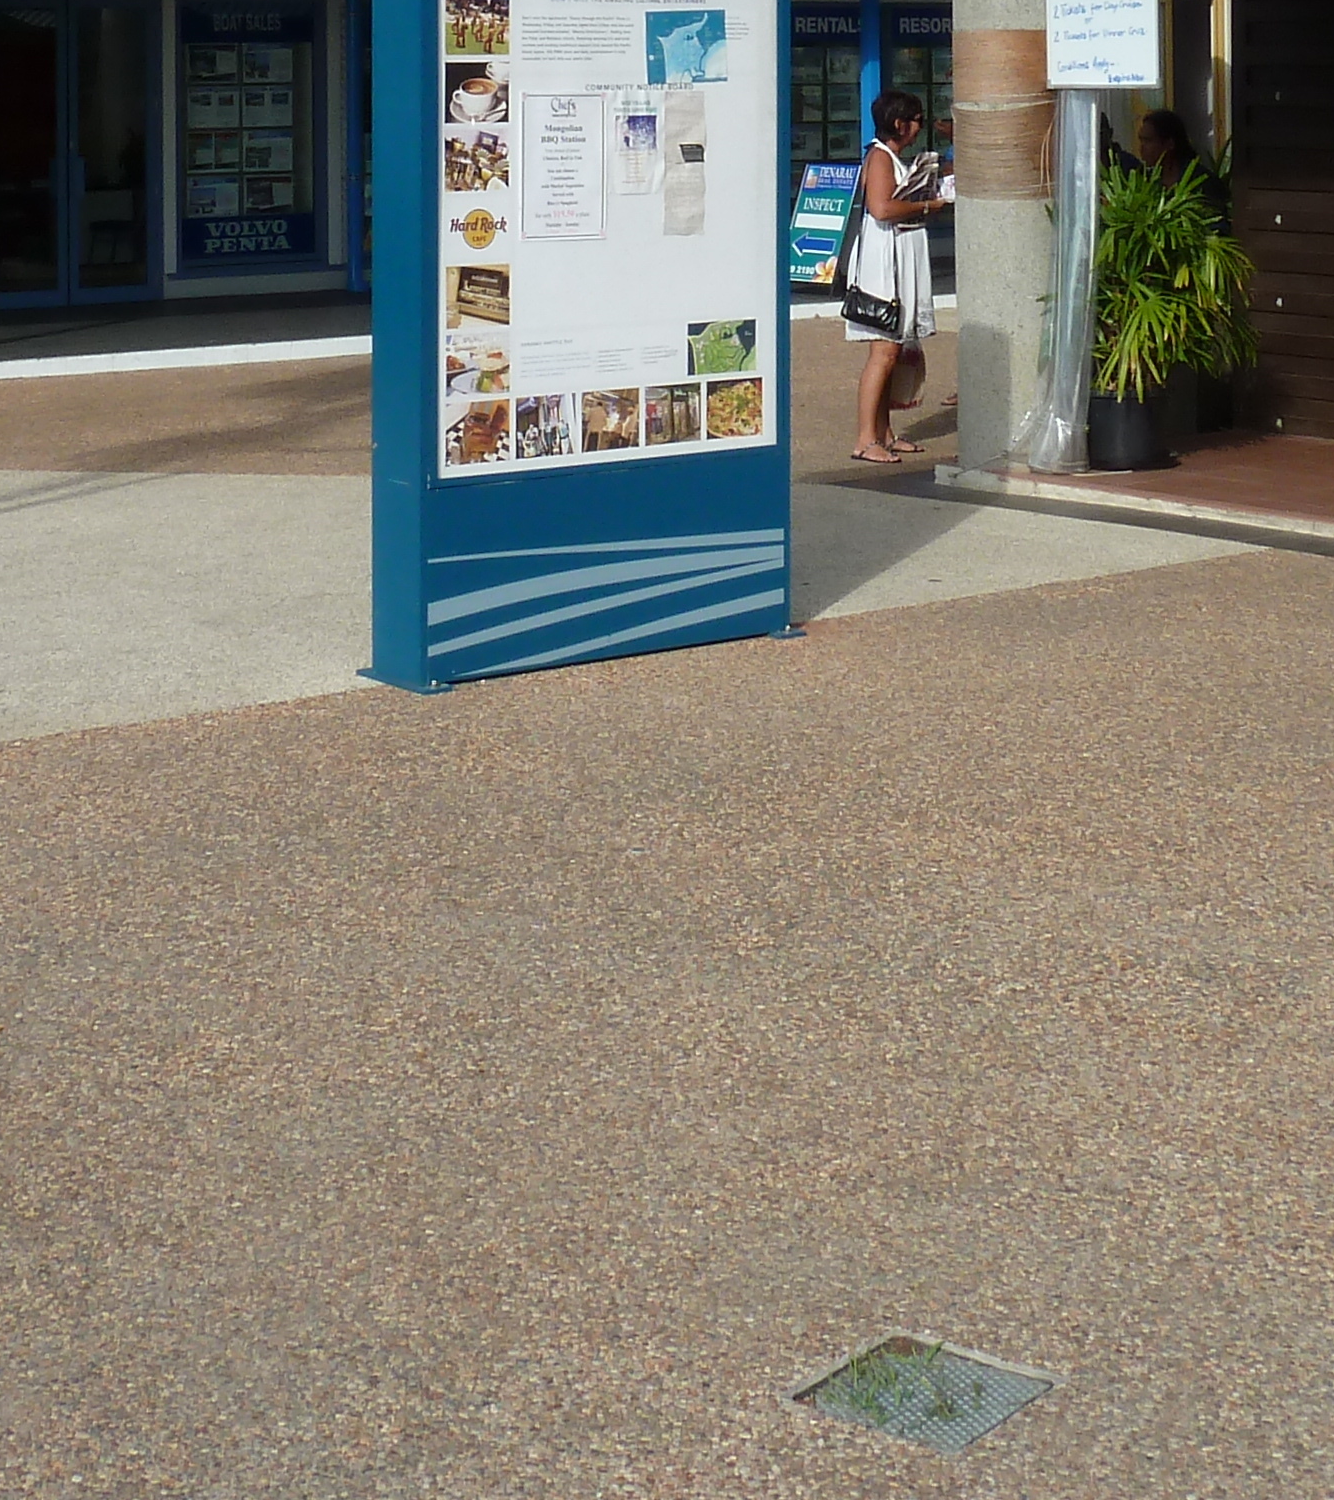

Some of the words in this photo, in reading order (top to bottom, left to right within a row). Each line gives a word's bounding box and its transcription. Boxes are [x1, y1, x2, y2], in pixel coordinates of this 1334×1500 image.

[213, 13, 244, 32] BOAT
[246, 12, 282, 31] SALES
[898, 17, 953, 34] RESOR
[585, 83, 634, 92] COMMUNITY
[819, 166, 857, 179] DENARAU
[803, 197, 845, 212] INSPECT
[204, 219, 288, 237] VOLVO
[450, 216, 479, 233] Hard
[480, 215, 507, 233] Rock
[203, 235, 292, 254] PENTA
